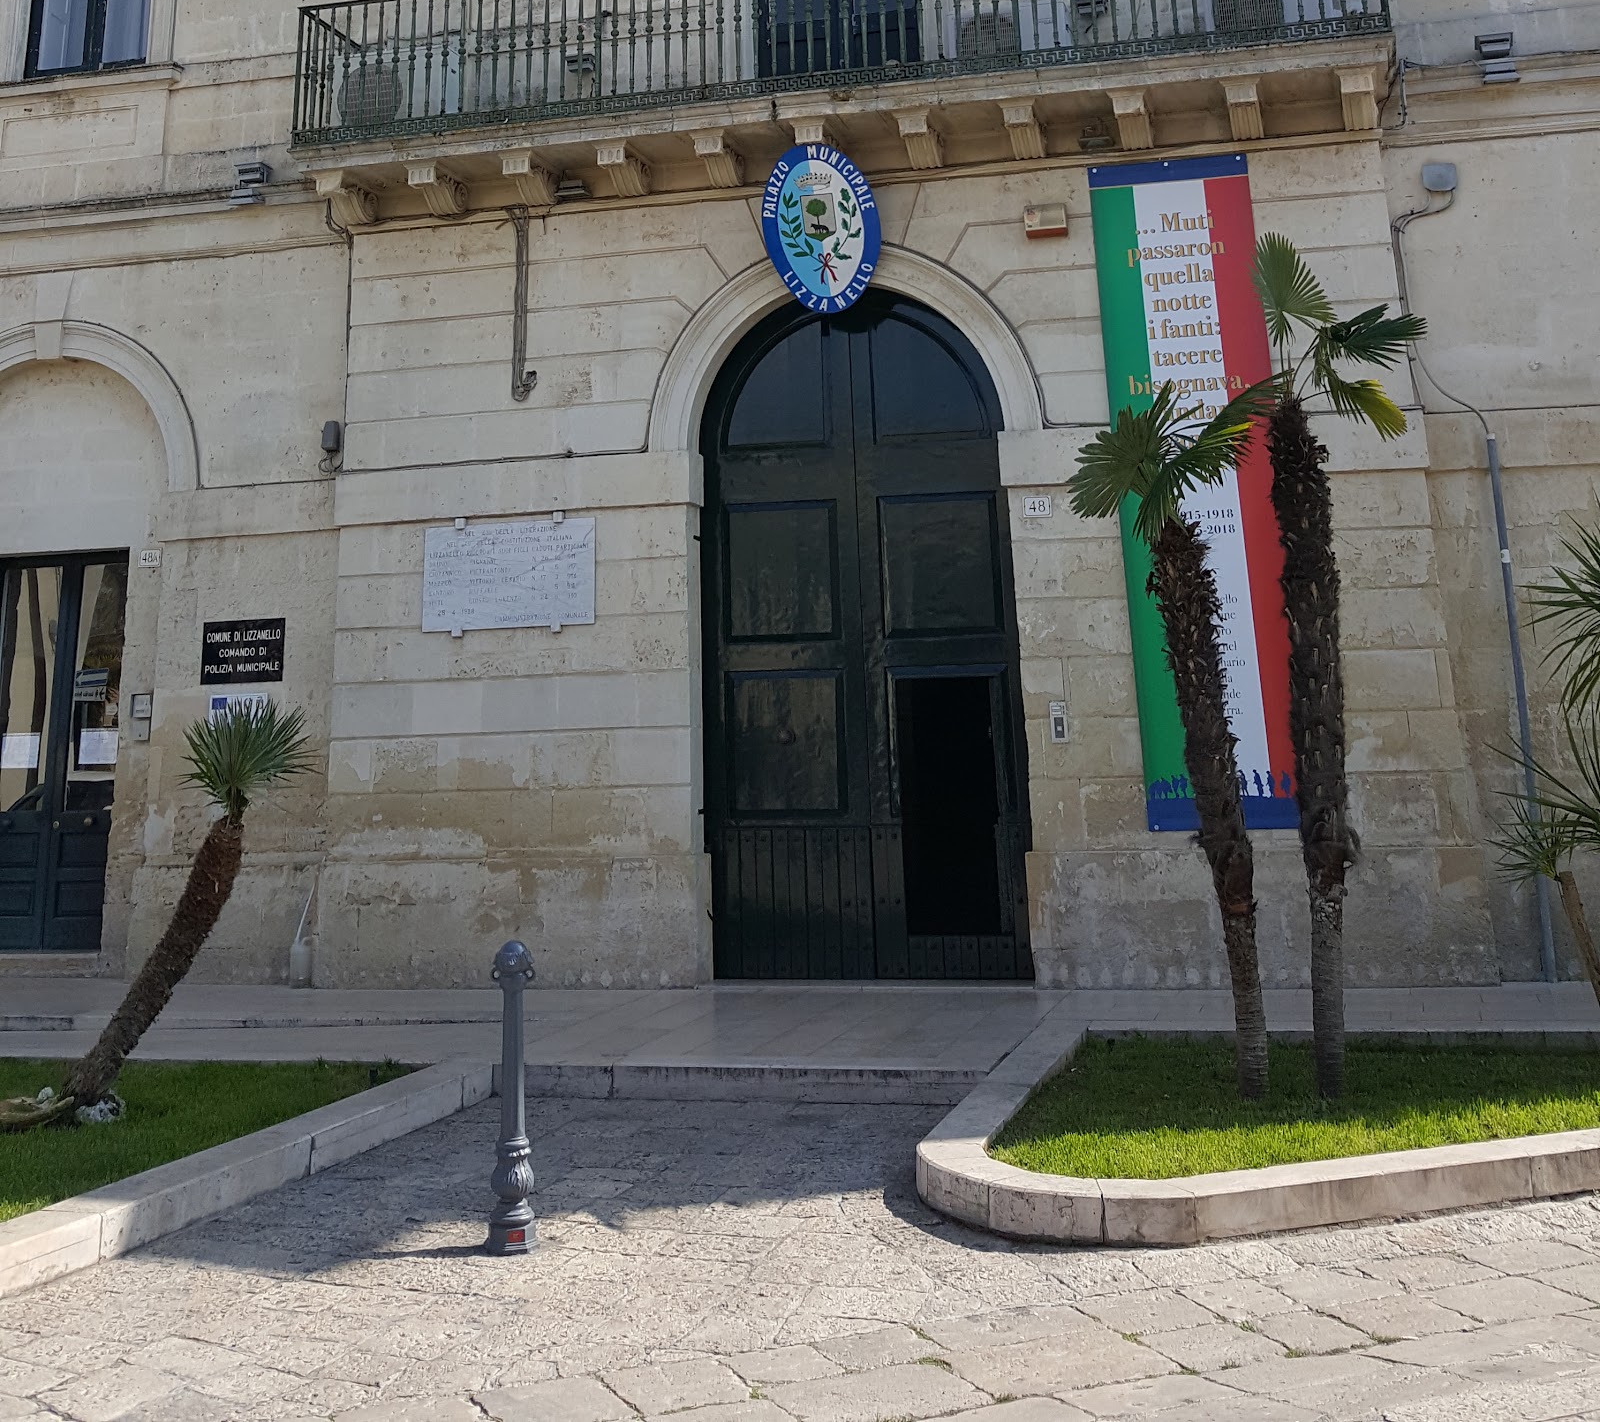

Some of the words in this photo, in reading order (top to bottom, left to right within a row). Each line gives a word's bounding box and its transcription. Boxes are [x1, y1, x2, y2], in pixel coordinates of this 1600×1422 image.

[763, 161, 790, 219] PALAZZO
[806, 145, 875, 211] MUNICIPALE
[1127, 241, 1225, 268] passaron
[783, 262, 874, 312] LIZZANELLO
[1143, 262, 1215, 293] quella
[1152, 293, 1212, 313] notte
[1147, 319, 1158, 340] i
[1160, 315, 1221, 339] fanti:
[1152, 348, 1223, 367] tacere
[1029, 499, 1046, 513] 48
[206, 631, 232, 644] COMUNE
[233, 630, 241, 642] DI
[243, 628, 281, 642] LIZZANELLO
[218, 647, 256, 658] COMANDO
[259, 646, 267, 656] DI
[204, 663, 233, 675] POLIZIA
[236, 661, 280, 673] MUNICIPALE
